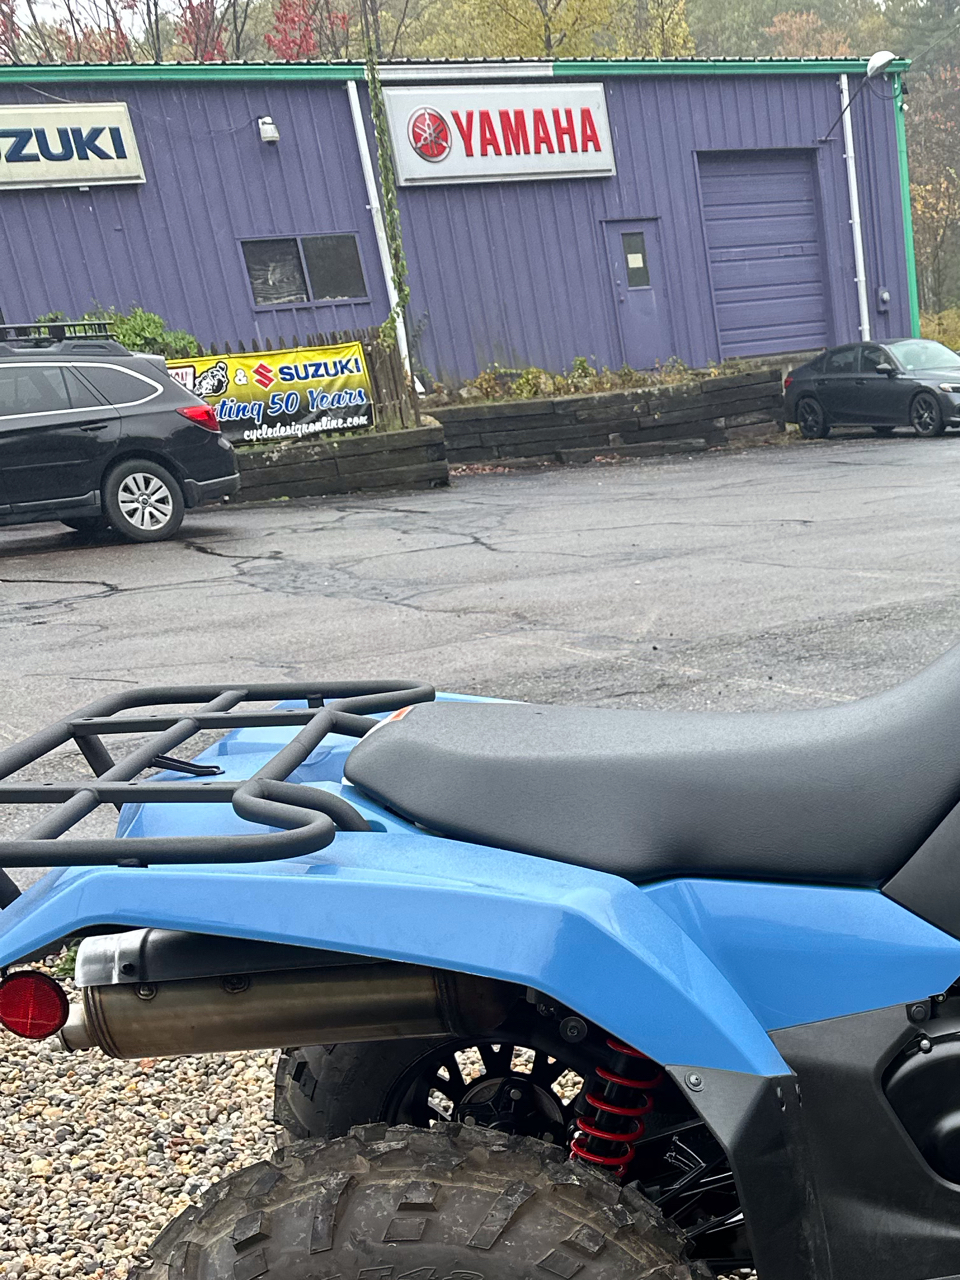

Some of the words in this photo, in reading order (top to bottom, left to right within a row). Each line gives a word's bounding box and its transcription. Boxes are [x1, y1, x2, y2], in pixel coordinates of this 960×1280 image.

[0, 126, 127, 163] ZUKI
[451, 107, 601, 157] YAMAHA
[234, 369, 248, 385] &
[279, 357, 361, 382] SUZUKI
[215, 398, 264, 424] ting
[267, 390, 300, 416] 50
[307, 387, 366, 412] Years
[243, 416, 368, 441] cycledesignonline.com
